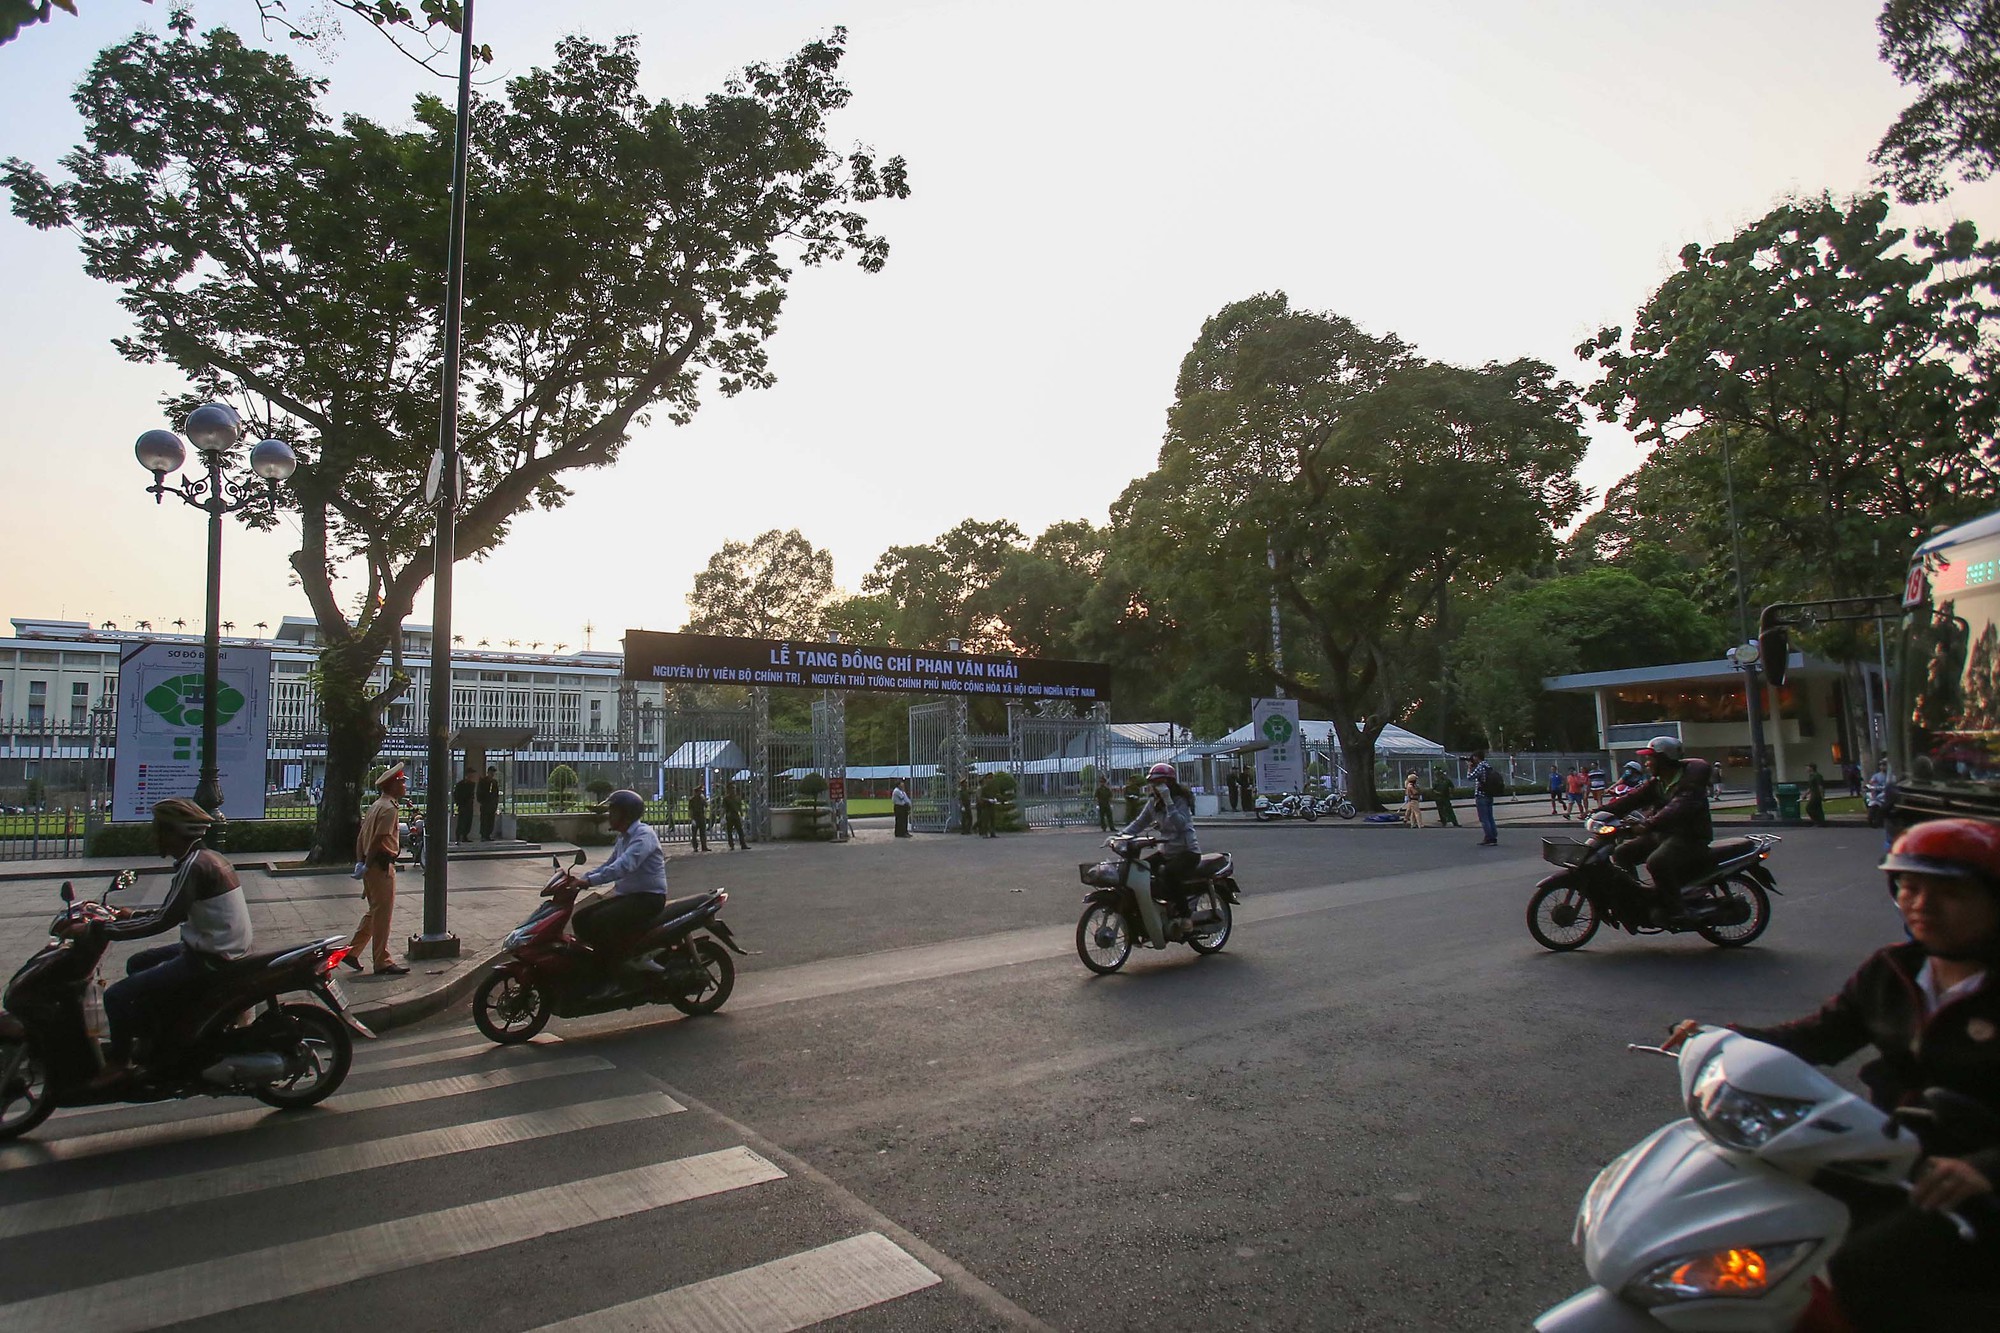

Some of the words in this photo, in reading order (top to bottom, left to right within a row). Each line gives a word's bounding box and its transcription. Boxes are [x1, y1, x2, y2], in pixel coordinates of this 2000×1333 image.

[770, 643, 790, 665] LỄ
[796, 650, 838, 668] TANG
[841, 648, 883, 670] ĐỒNG
[887, 654, 912, 672] CHÍ
[916, 658, 952, 674] PHAN
[956, 659, 983, 676] VĂN
[987, 660, 1018, 678] KHẢI
[653, 664, 693, 678] NGUYÊN
[697, 664, 710, 679] ỦY
[713, 666, 736, 680] VIÊN
[738, 667, 752, 683] BỘ
[754, 668, 783, 682] CHÍNH
[811, 672, 846, 685] NGUYÊN
[848, 672, 865, 686] THỦ
[868, 675, 895, 688] TƯỚNG
[897, 676, 921, 689] CHÍNH
[923, 676, 939, 689] PHỦ
[941, 678, 963, 691] NƯỚC
[964, 679, 984, 693] CỘNG
[1014, 682, 1026, 695] HỘI
[1065, 685, 1079, 697] VIỆT
[1081, 687, 1096, 697] NAM
